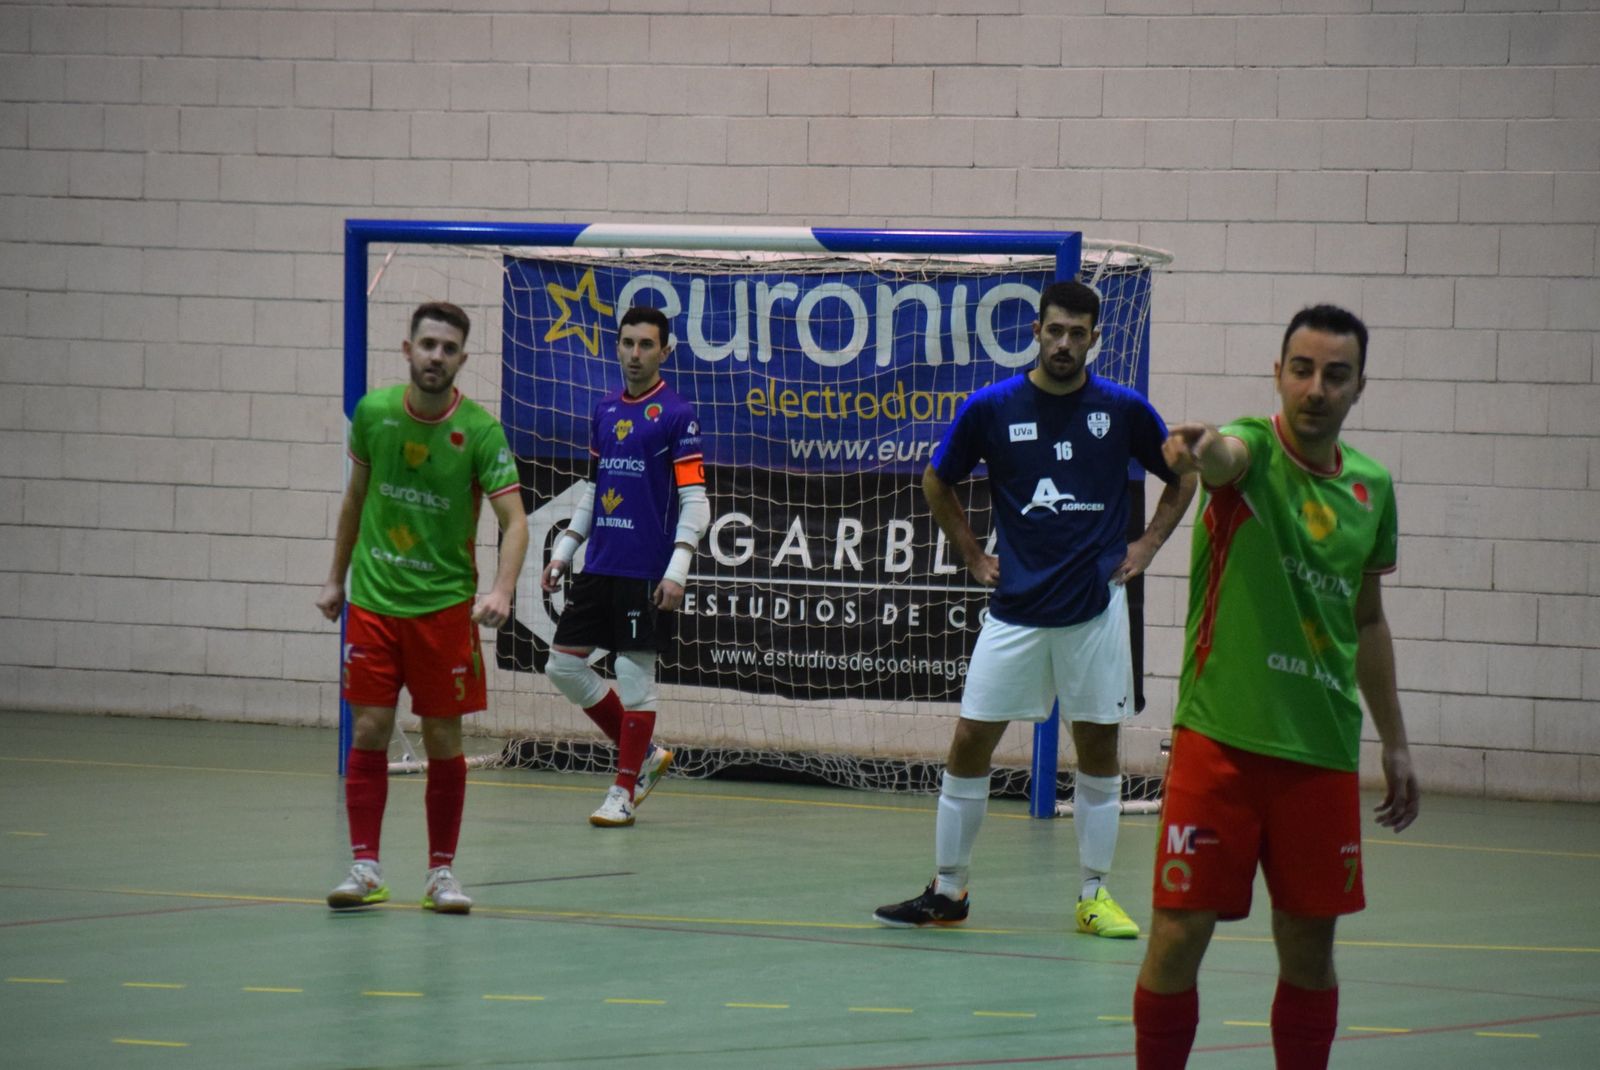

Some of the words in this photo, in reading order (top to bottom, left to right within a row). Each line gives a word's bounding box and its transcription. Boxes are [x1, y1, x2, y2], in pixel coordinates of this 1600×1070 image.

[616, 274, 1102, 368] euronic
[746, 378, 969, 420] electrodom
[1013, 428, 1033, 436] UVa
[599, 456, 646, 472] euronics
[1053, 441, 1073, 461] 16
[380, 483, 450, 510] euronics
[684, 593, 856, 624] ESTUDIOS
[882, 603, 920, 626] DE
[630, 619, 637, 639] 1
[1343, 858, 1358, 893] 7
